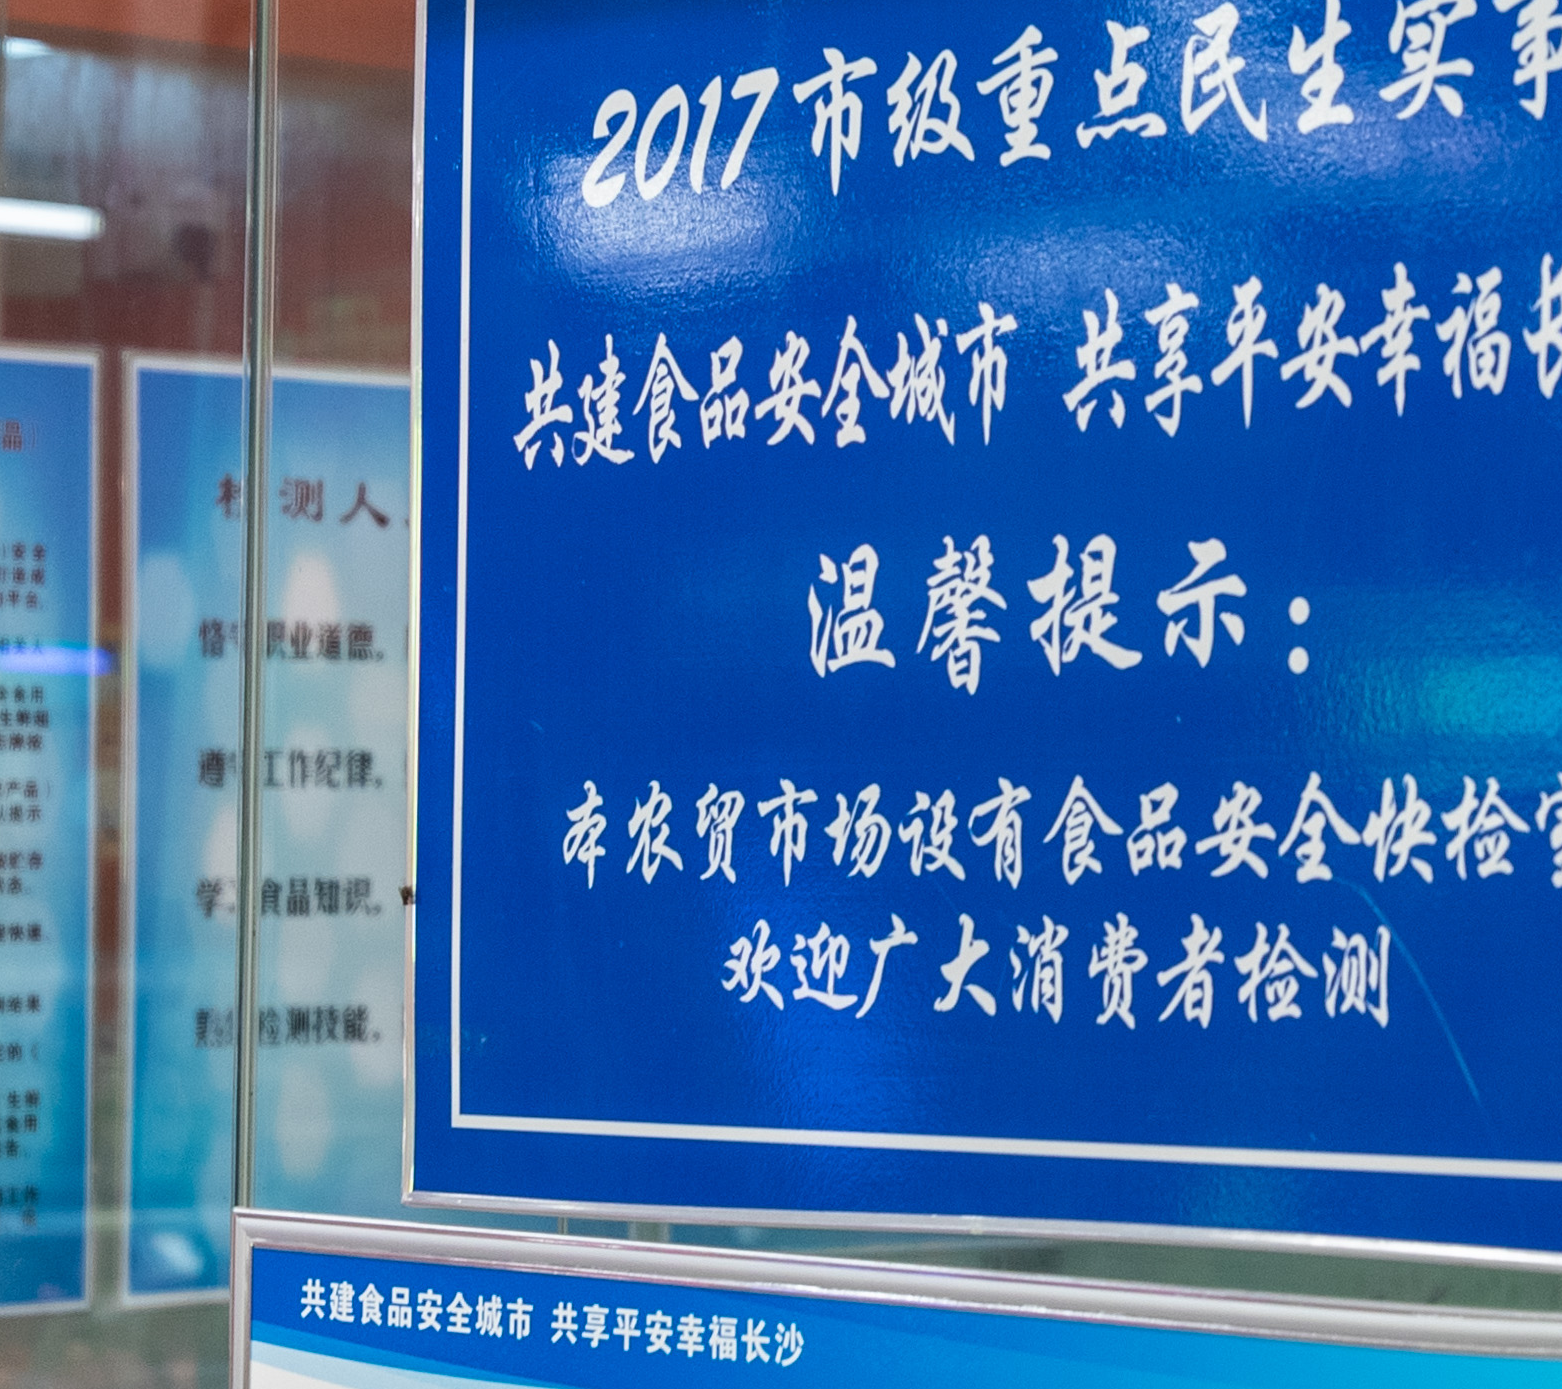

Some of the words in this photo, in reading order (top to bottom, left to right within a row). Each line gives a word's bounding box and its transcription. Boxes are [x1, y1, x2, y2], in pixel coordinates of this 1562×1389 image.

[512, 301, 1013, 473] 共建食品安全城市
[807, 532, 1312, 694] 温馨提示：
[720, 916, 1392, 1029] 欢迎广大消费者检测
[299, 1276, 535, 1344] 共建食品安全城市
[549, 1302, 807, 1370] 共享平安幸福长沙
